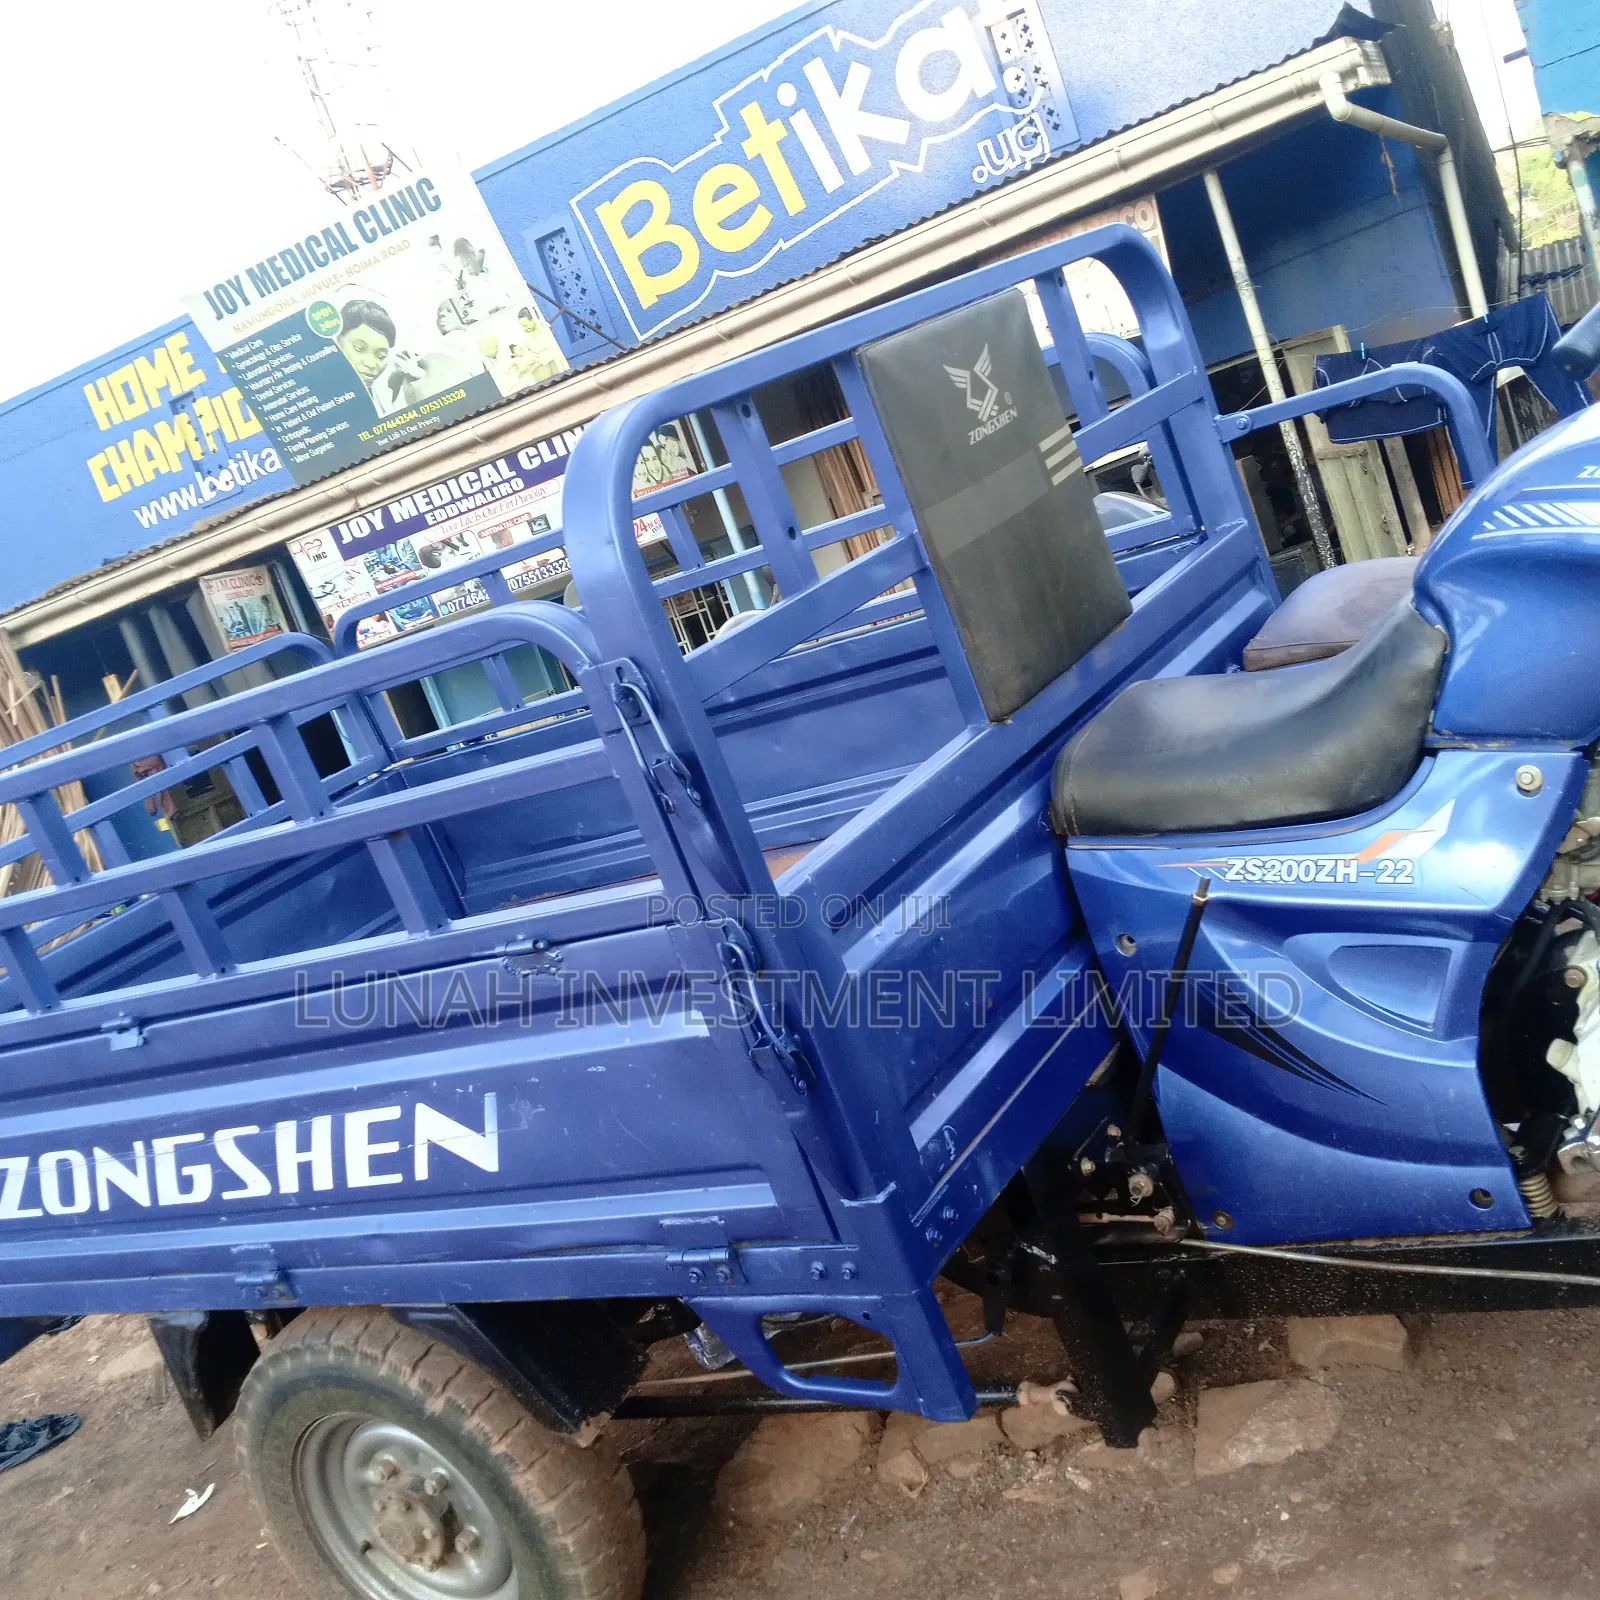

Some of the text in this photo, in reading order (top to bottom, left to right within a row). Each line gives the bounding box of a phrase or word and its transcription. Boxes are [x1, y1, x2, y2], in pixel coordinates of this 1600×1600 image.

[203, 178, 441, 321] JOY MEDICAL CLINIC
[345, 256, 381, 278] HOIMA
[381, 239, 411, 262] ROAD
[228, 339, 264, 360] Medical Care
[280, 333, 303, 347] Service
[82, 331, 206, 431] HOME
[242, 362, 272, 380] Laboratory
[248, 375, 275, 391] Voluntary
[282, 361, 303, 376] Testing
[300, 357, 308, 366] &
[255, 379, 297, 401] Dental Services
[262, 385, 311, 412] Antenatal Services
[419, 388, 467, 415] 0753133328
[268, 395, 319, 423] Home Care Nursing
[275, 391, 356, 433] In Patient & Out Patient Service
[288, 421, 351, 454] Family Planning Services
[375, 414, 440, 447] Your Life Is Our Priority
[968, 406, 1018, 446] ZONGSHEN
[292, 441, 335, 464] Minor Surgeries
[337, 507, 384, 544] JOY
[388, 460, 516, 524] MEDICAL
[424, 476, 524, 526] EDDWALIRO
[481, 513, 532, 538] ANTENATAL CARE
[632, 518, 648, 539] 24
[312, 551, 328, 563] JMC
[1225, 858, 1415, 884] ZS200ZH-22
[0, 1091, 499, 1219] ZONGSHEN
